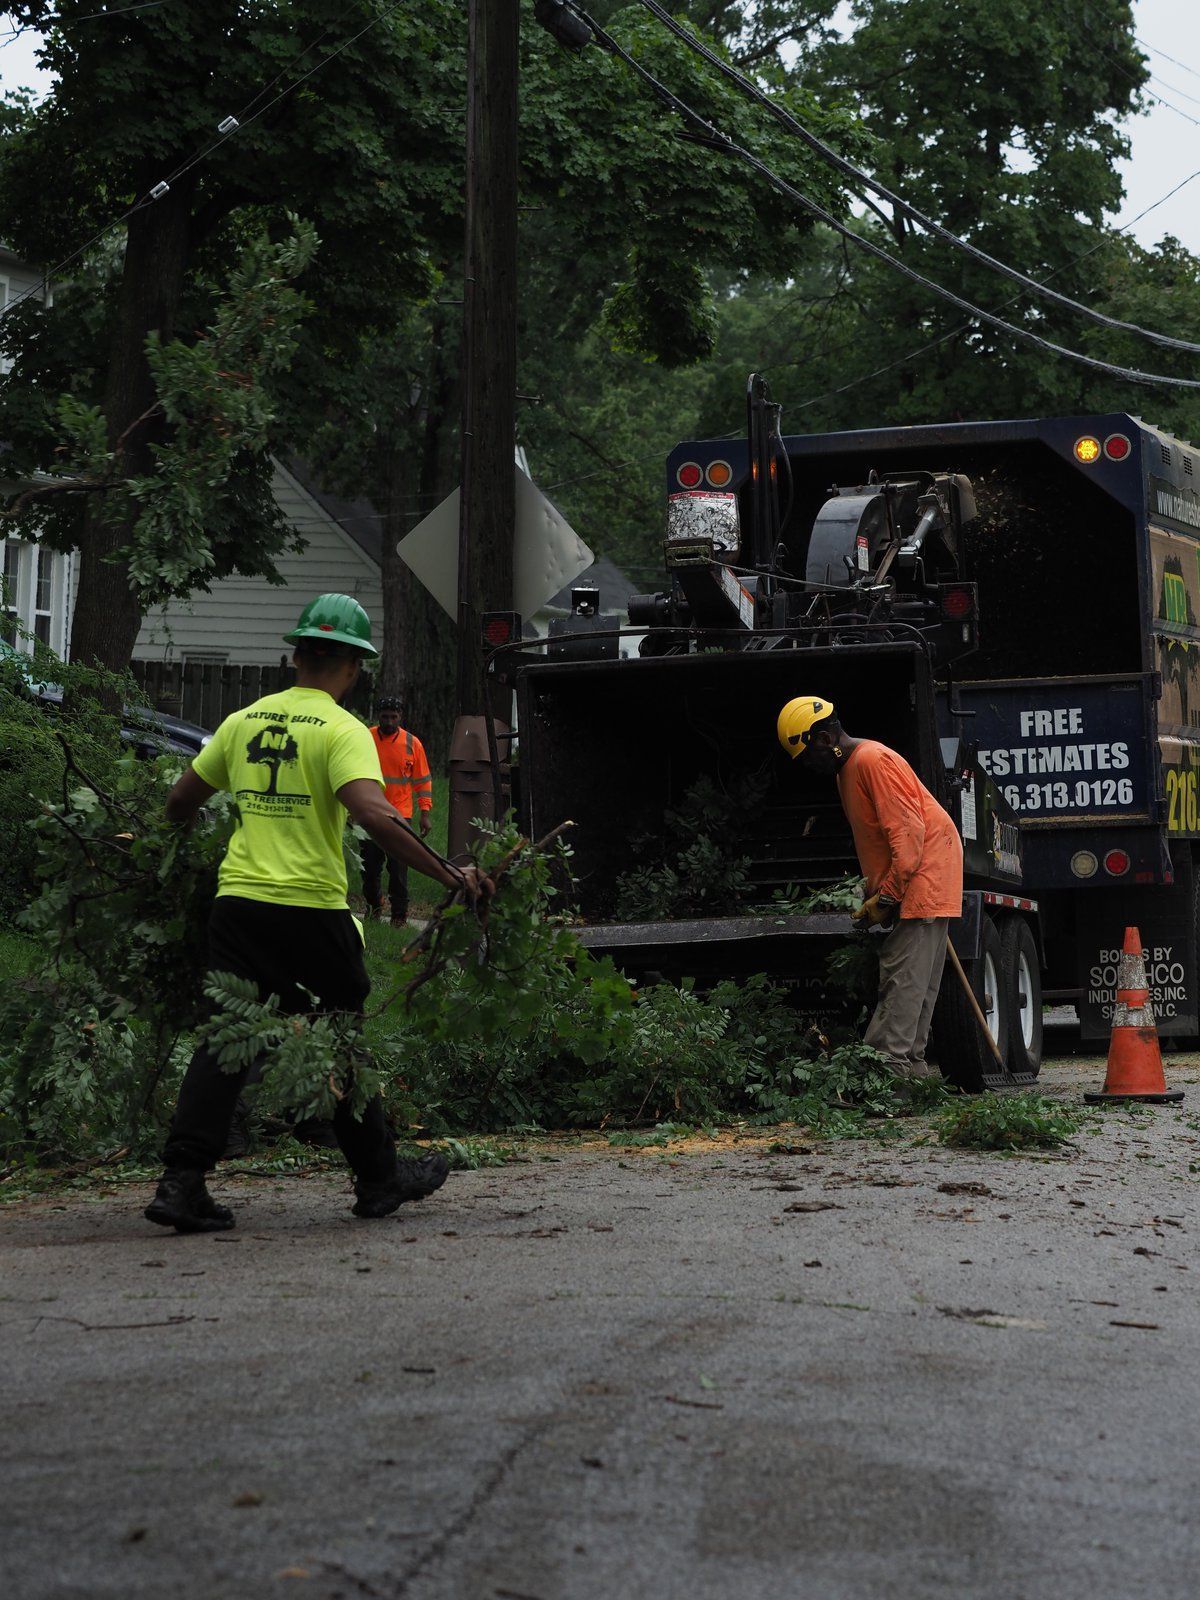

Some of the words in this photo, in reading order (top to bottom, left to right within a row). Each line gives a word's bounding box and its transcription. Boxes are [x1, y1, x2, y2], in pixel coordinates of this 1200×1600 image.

[291, 714, 328, 727] BEAUTY
[1020, 708, 1084, 738] FREE
[977, 742, 1130, 776] ESTIMATES
[253, 794, 275, 804] TREE
[277, 796, 311, 806] SERVICE
[998, 778, 1134, 811] 6.313.0126
[1153, 946, 1173, 962] BY
[1089, 962, 1185, 987] SOHCO
